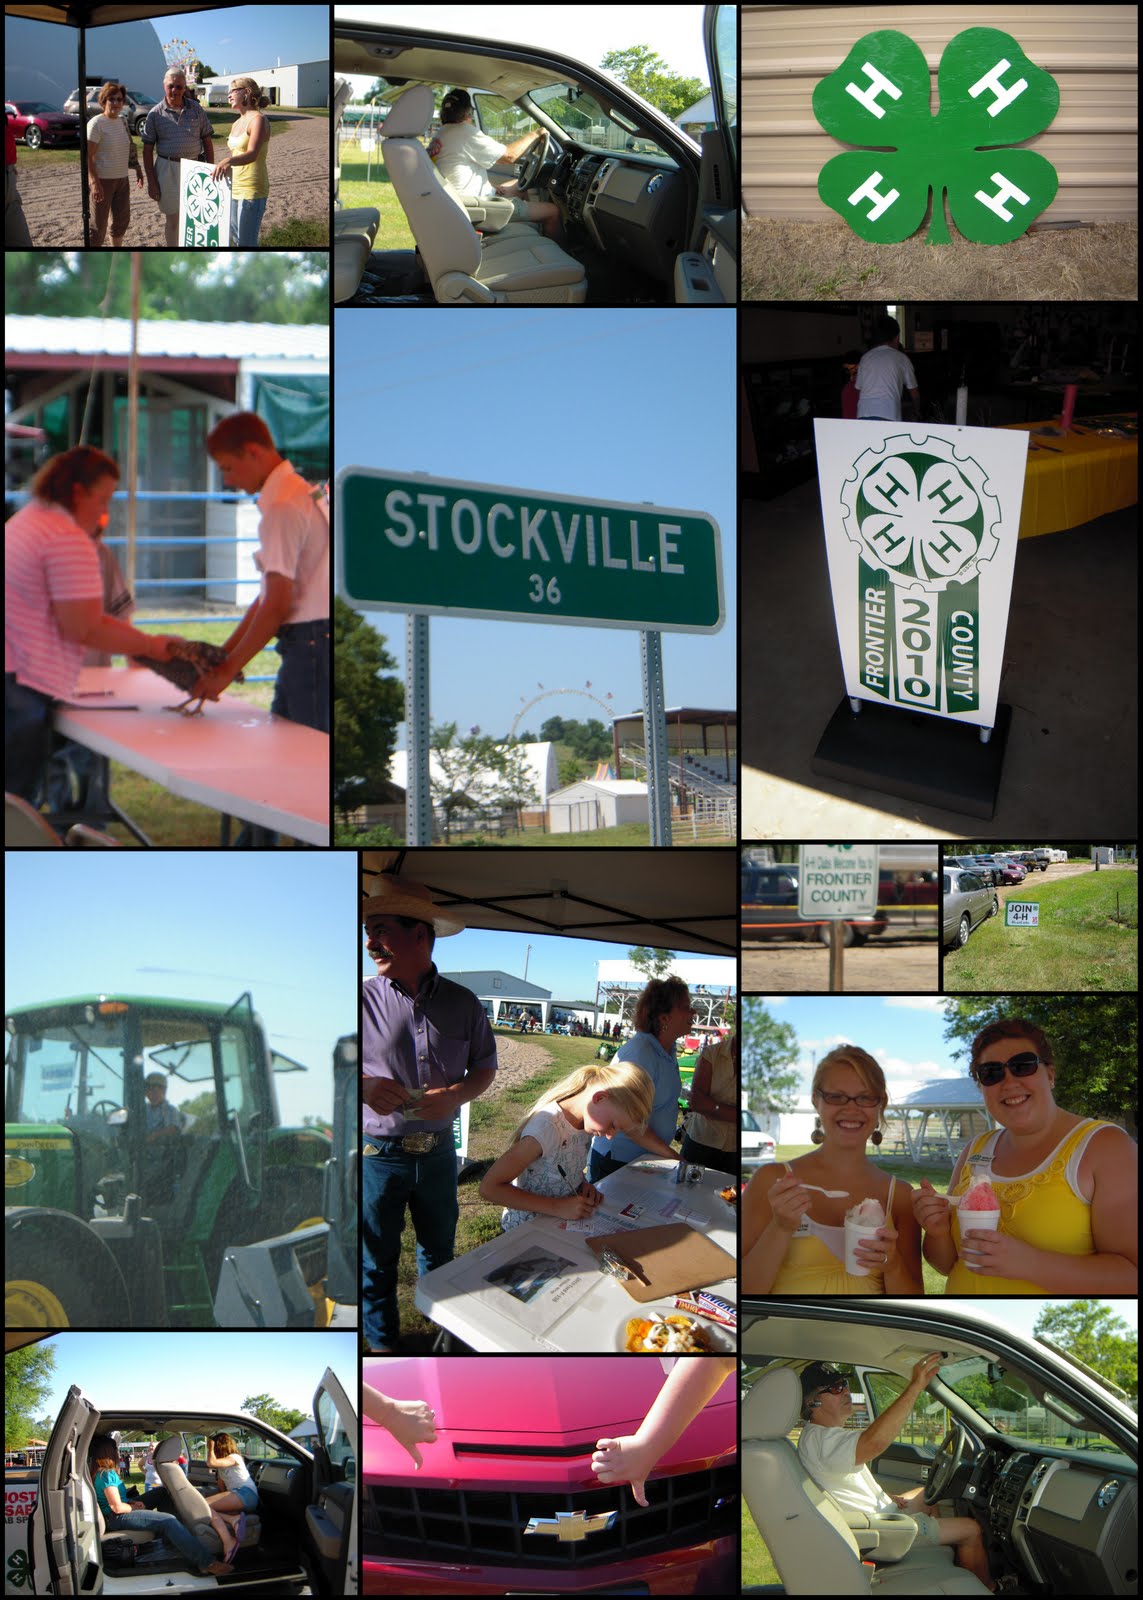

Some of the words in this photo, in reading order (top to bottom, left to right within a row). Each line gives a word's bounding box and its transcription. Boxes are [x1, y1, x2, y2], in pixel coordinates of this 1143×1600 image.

[845, 61, 903, 120] H
[967, 58, 1029, 118] H
[847, 170, 900, 222] H
[974, 171, 1031, 223] H
[874, 471, 910, 508] H
[927, 479, 964, 514] H
[384, 489, 685, 574] STOCKVILLE
[872, 522, 906, 554] H
[928, 530, 963, 563] H
[528, 573, 562, 605] 36
[865, 587, 886, 688] FRONTIER
[901, 598, 931, 698] 2010
[951, 609, 974, 702] COUNTY
[806, 872, 872, 885] FRONTIER
[811, 889, 866, 903] COUNTY
[1009, 904, 1032, 913] JOIN
[1013, 913, 1028, 921] 4-H
